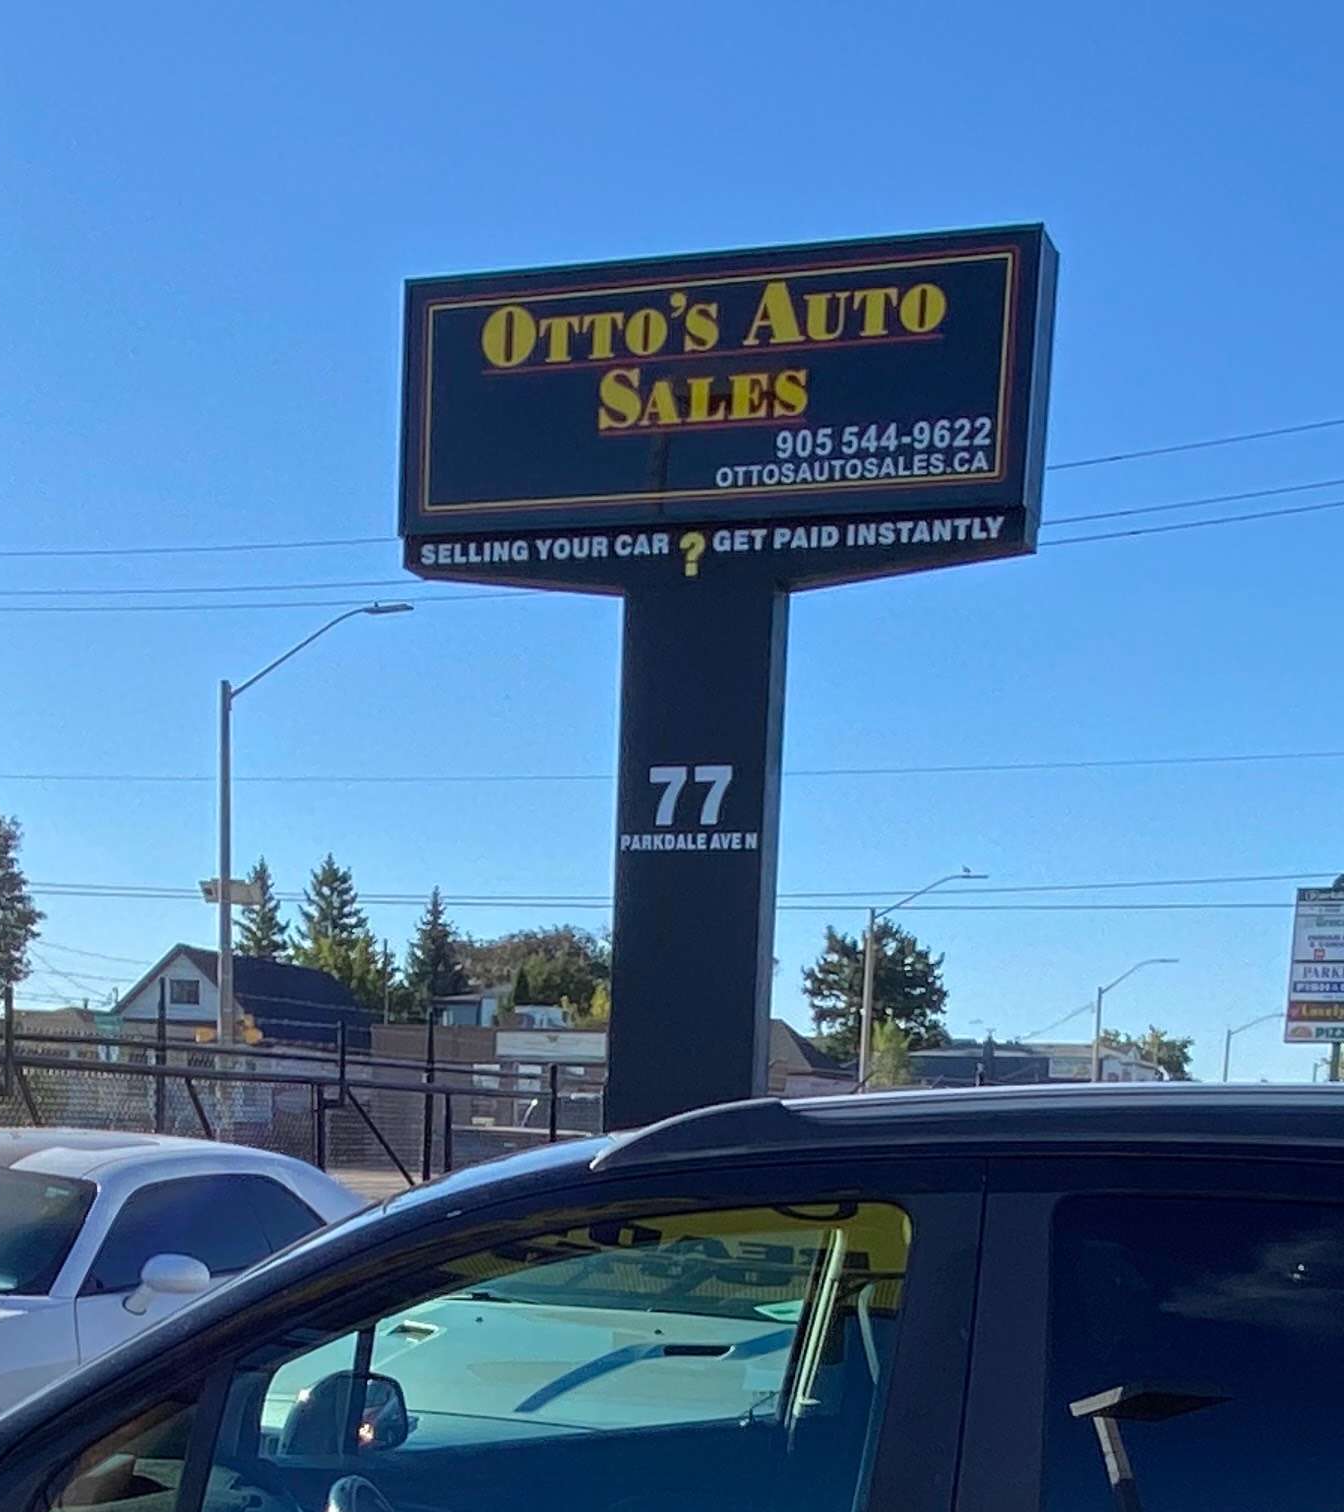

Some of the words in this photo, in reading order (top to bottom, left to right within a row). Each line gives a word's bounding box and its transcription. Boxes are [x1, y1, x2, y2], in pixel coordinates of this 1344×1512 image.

[742, 279, 947, 347] AUTO
[598, 369, 808, 430] SALES
[776, 428, 833, 459] 905
[841, 416, 992, 454] 544-9622
[715, 450, 990, 488] OTTOSAUTOSALES.CA
[420, 540, 529, 565] SELLING
[535, 535, 609, 560] YOUR
[614, 532, 669, 556] CAR
[712, 528, 767, 551] GET
[773, 524, 840, 549] PAID
[846, 516, 1005, 547] INSTANTLY
[649, 765, 733, 826] 77
[620, 832, 706, 850] PARKDALE
[711, 832, 742, 849] AVE
[745, 832, 758, 849] N
